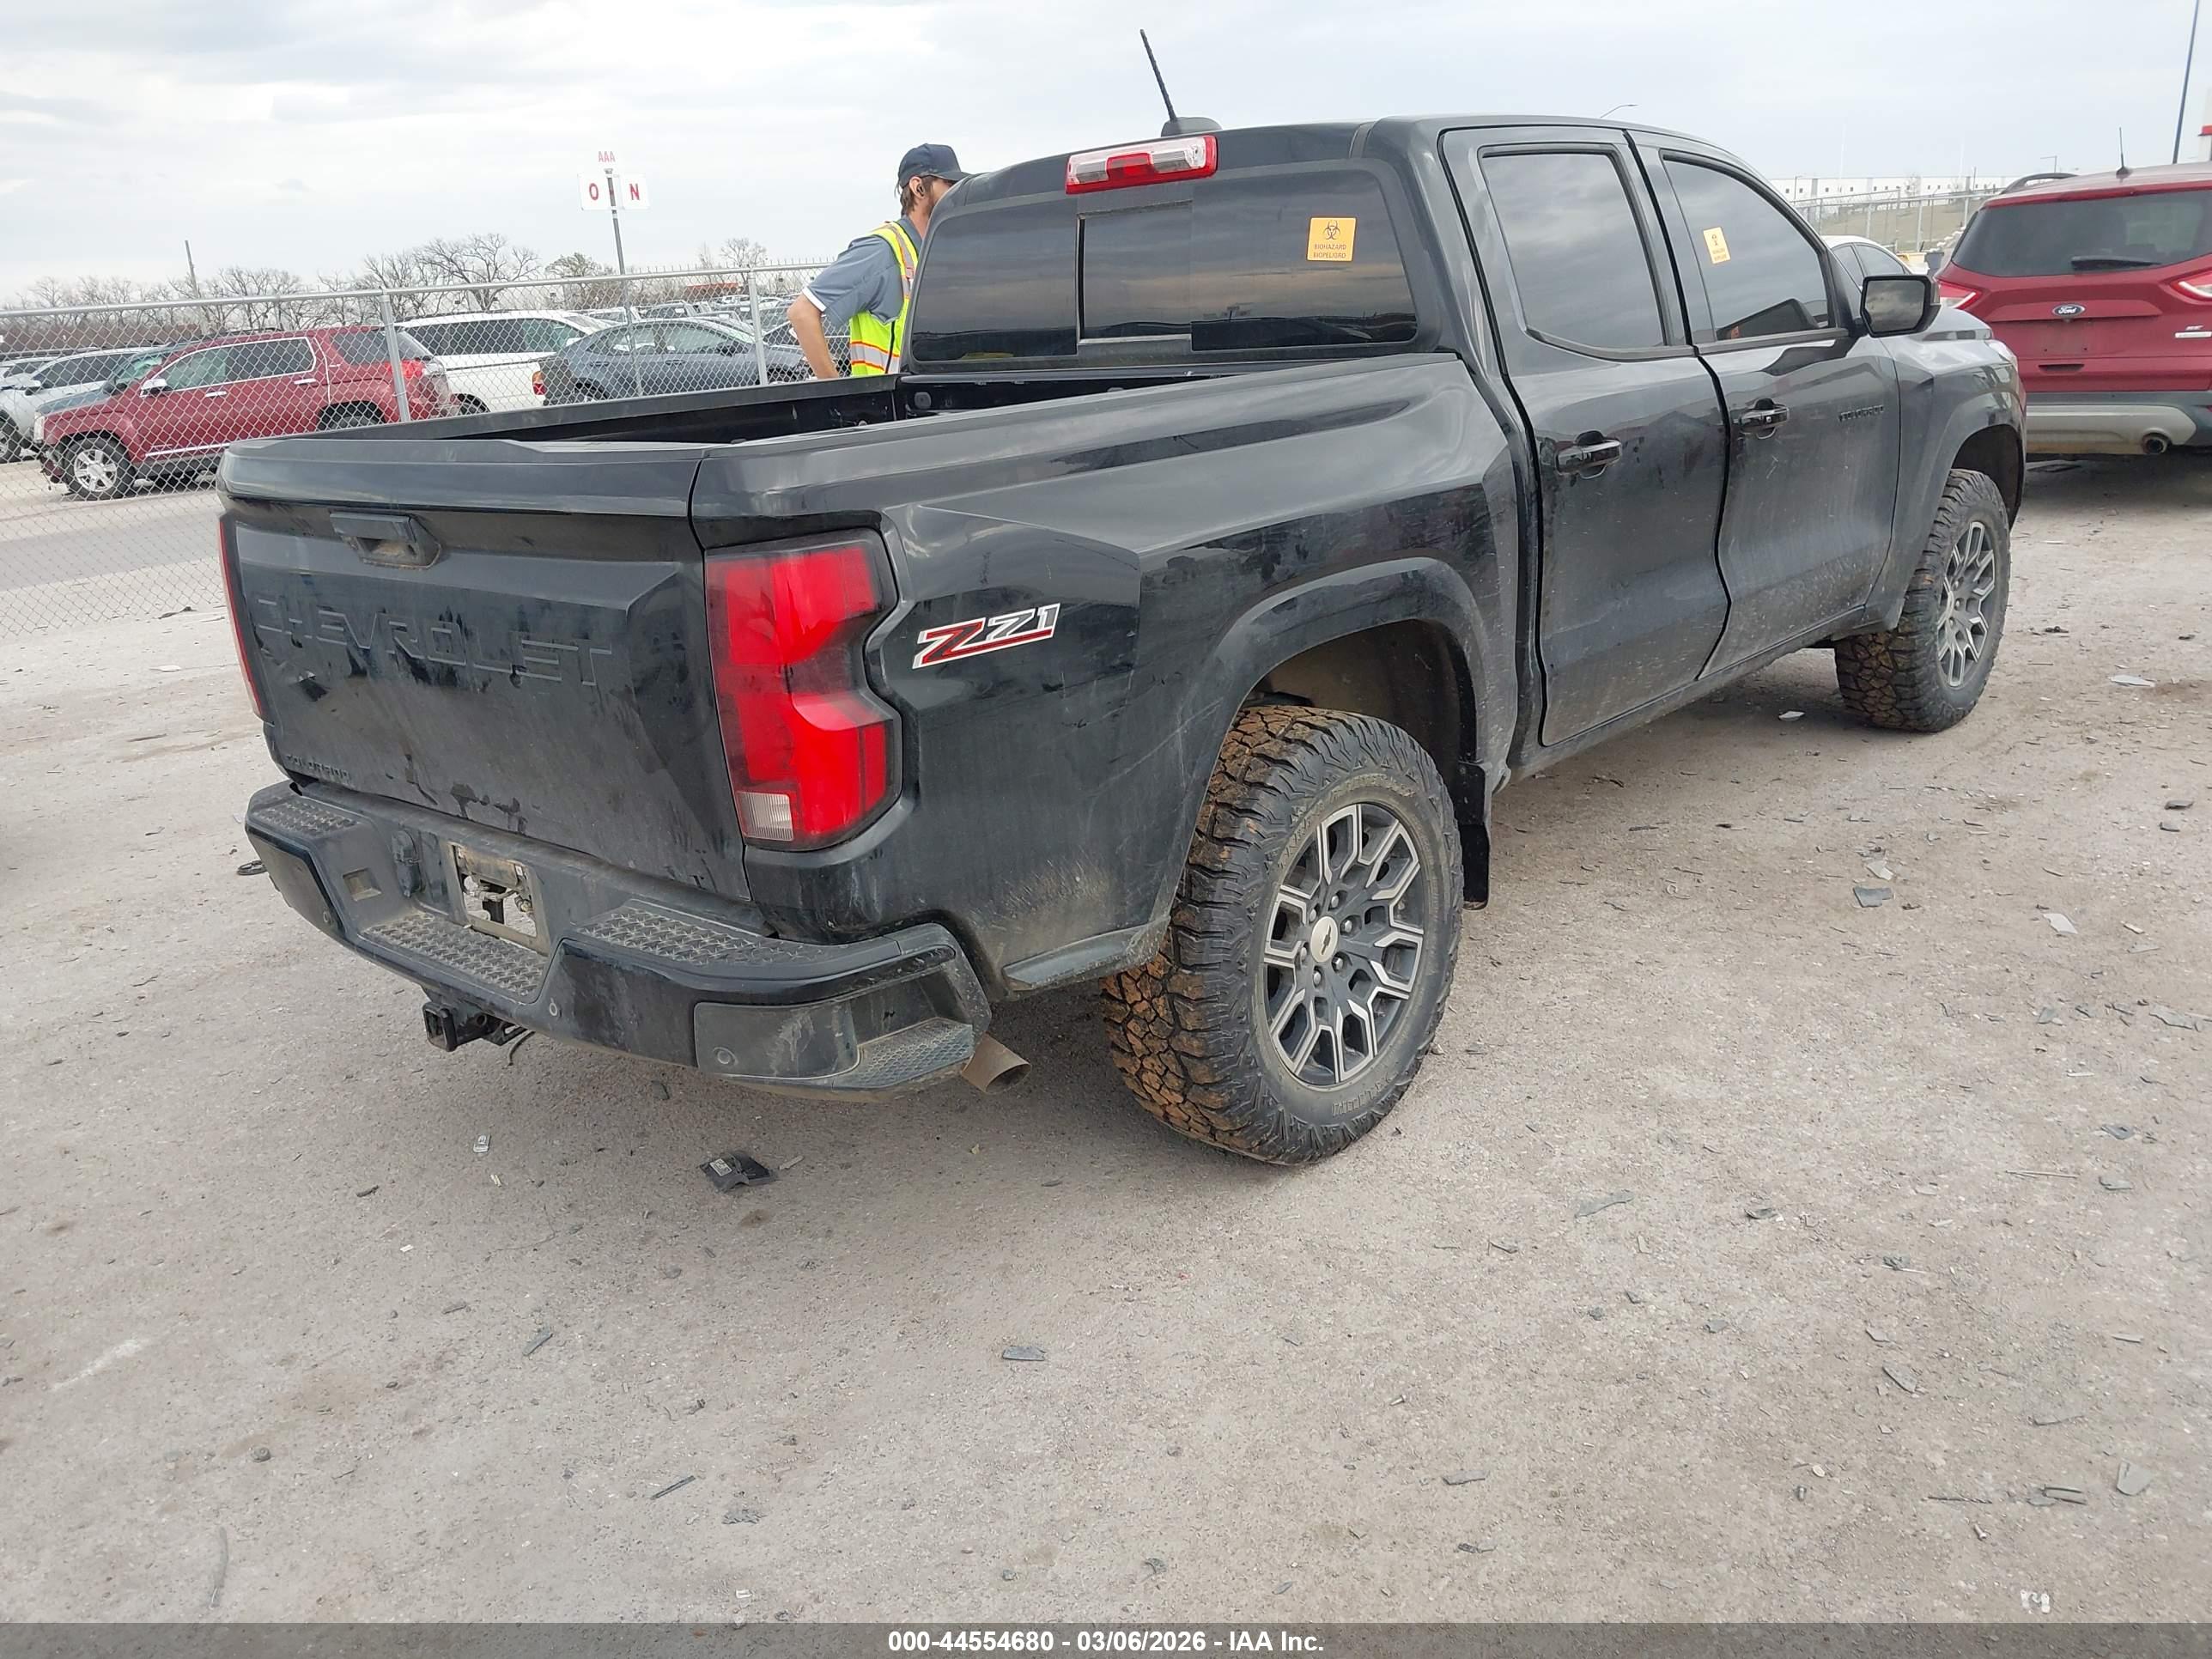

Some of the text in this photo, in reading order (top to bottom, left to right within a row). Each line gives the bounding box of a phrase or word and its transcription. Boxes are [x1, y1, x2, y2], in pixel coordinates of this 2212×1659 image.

[598, 151, 616, 162] AAA
[629, 183, 641, 200] N
[912, 603, 1061, 669] Z71
